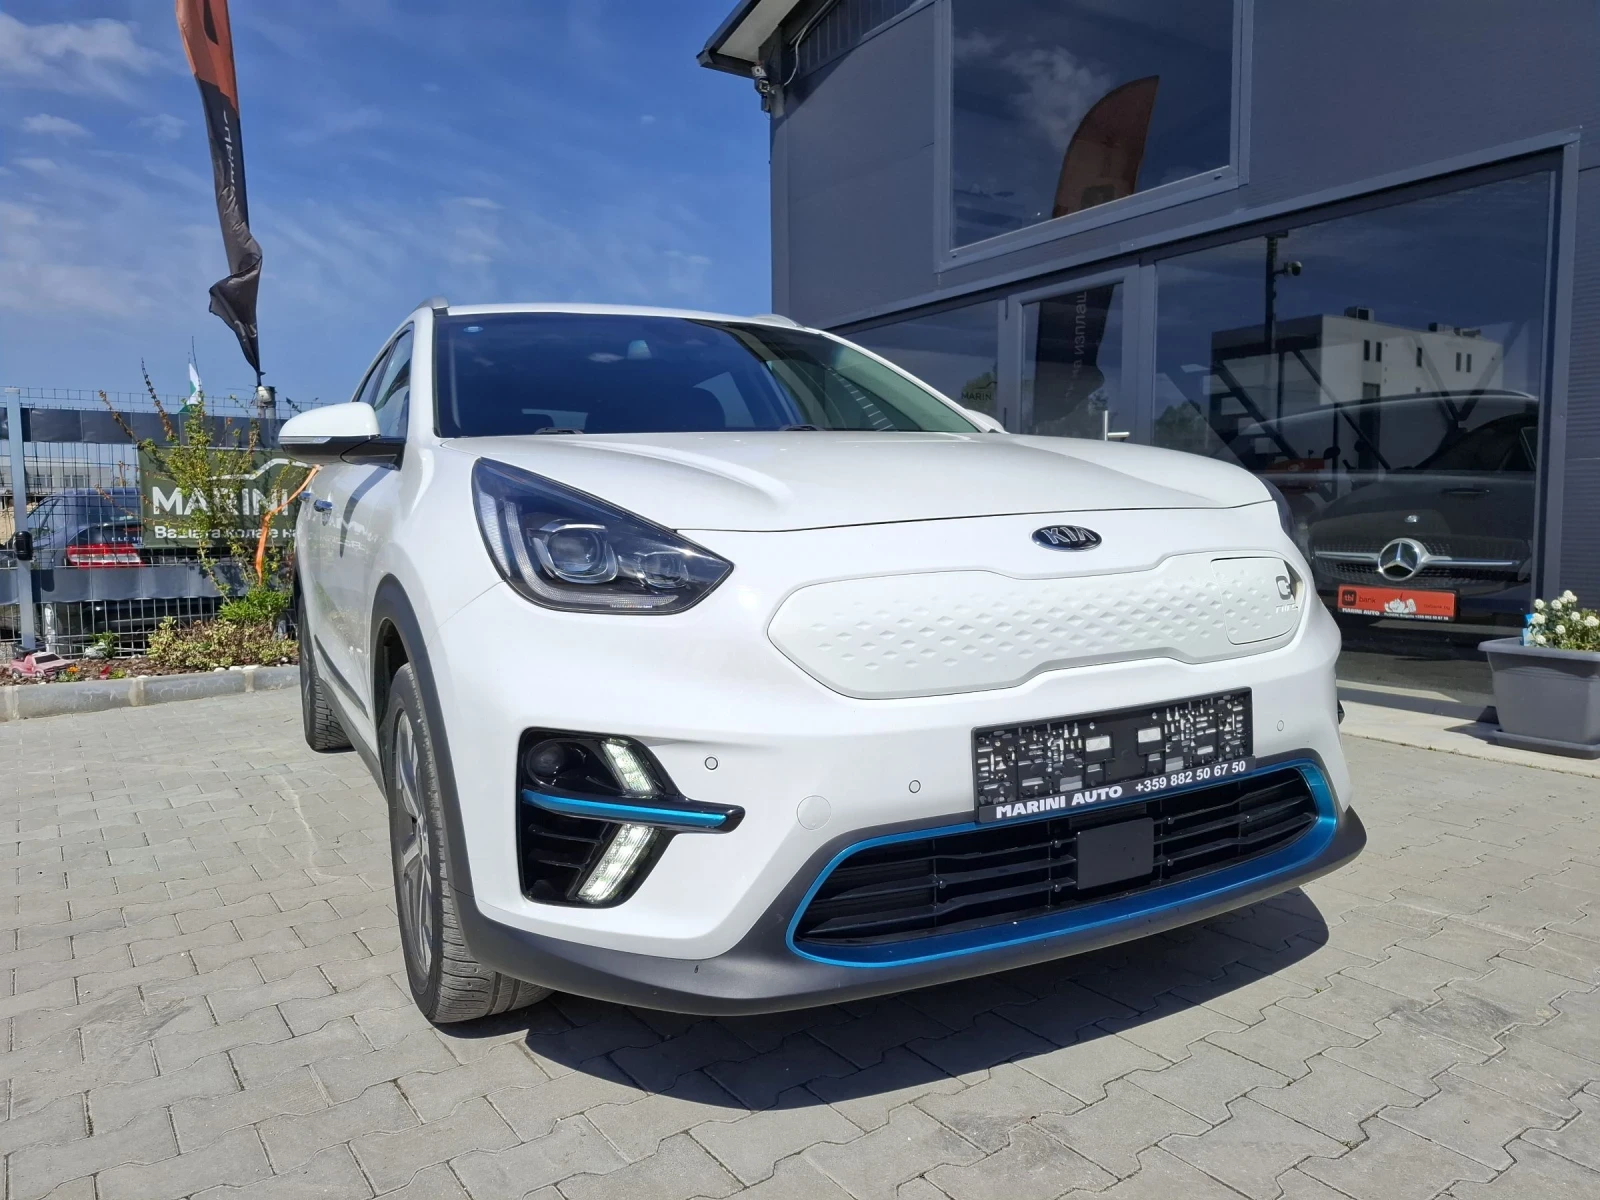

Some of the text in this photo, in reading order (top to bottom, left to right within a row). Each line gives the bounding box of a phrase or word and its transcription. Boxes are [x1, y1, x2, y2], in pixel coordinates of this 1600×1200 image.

[152, 486, 288, 516] MARINI
[154, 525, 220, 539] Вашаа
[1039, 526, 1098, 545] KIA
[1344, 594, 1377, 604] tbi bank
[996, 760, 1246, 819] MARINI AUTO +359 882 50 67 50
